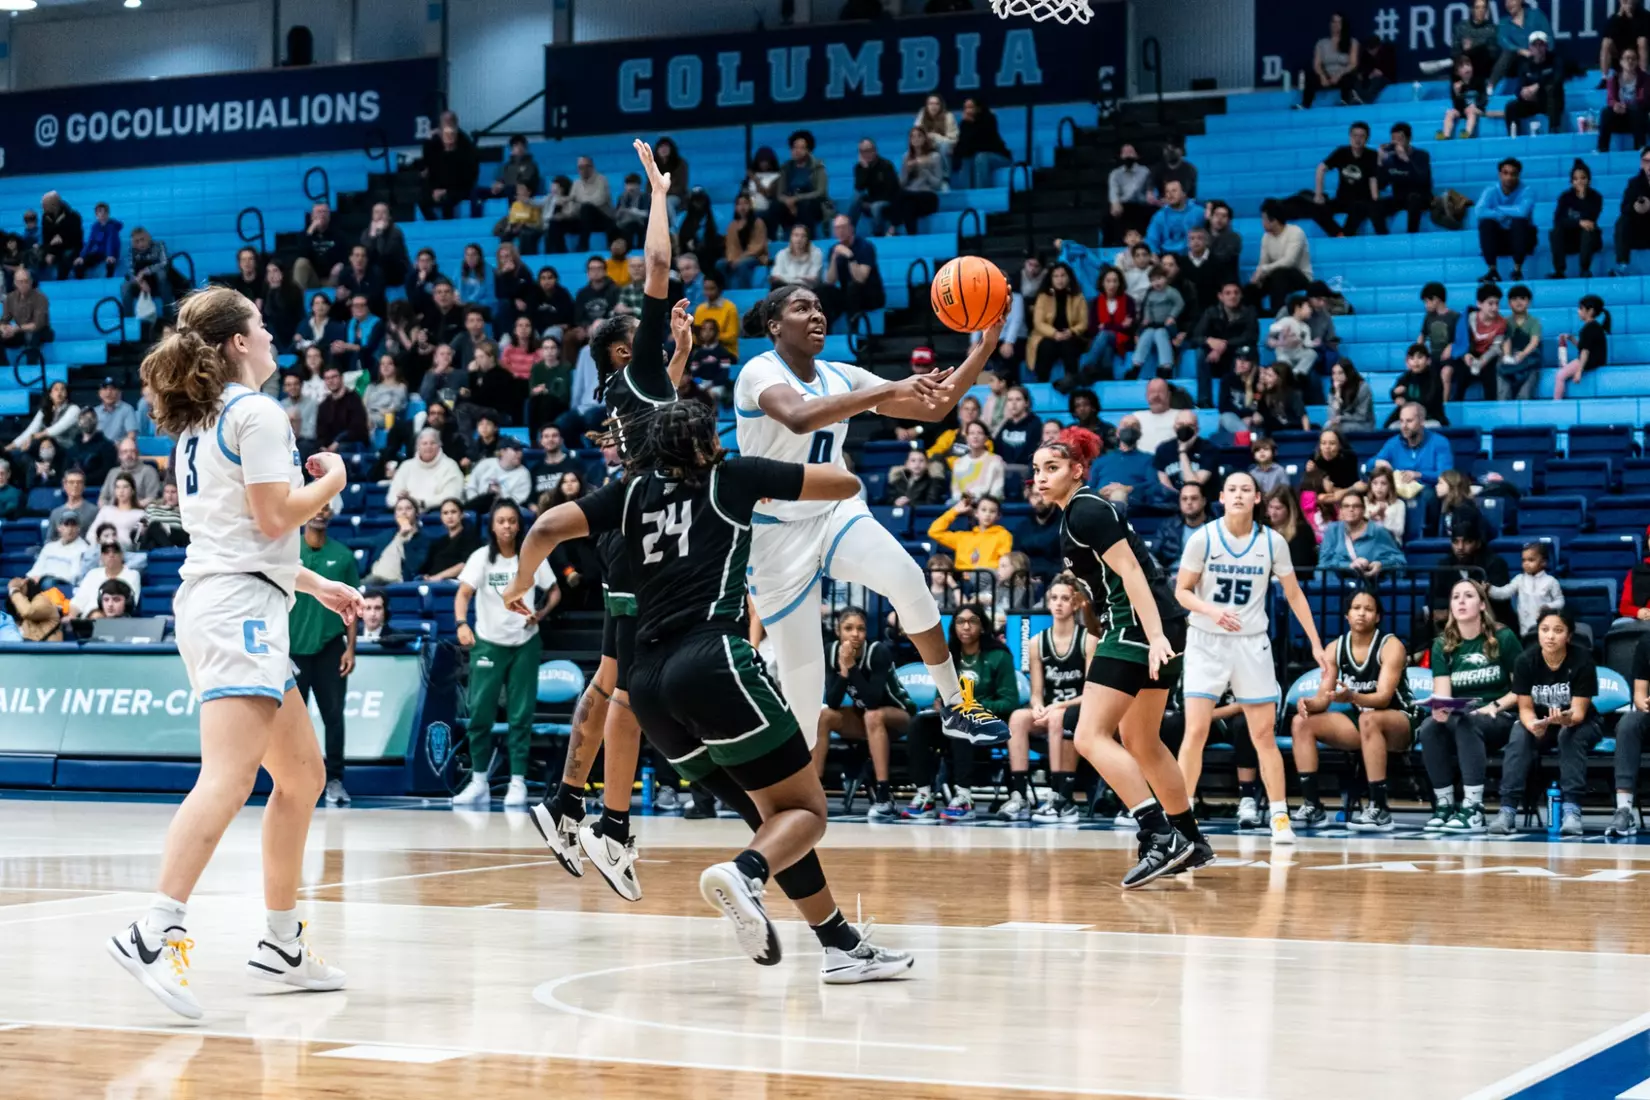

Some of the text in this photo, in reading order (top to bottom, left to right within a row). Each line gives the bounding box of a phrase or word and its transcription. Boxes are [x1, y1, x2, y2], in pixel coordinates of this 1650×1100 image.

[618, 28, 1043, 114] COLUMBIA
[185, 437, 199, 497] 3
[642, 500, 692, 565] 24
[1208, 564, 1264, 575] COLUMBIA
[1213, 577, 1253, 606] 35
[243, 619, 269, 655] C
[1044, 665, 1084, 687] Wagner
[1451, 665, 1500, 682] WAGNER
